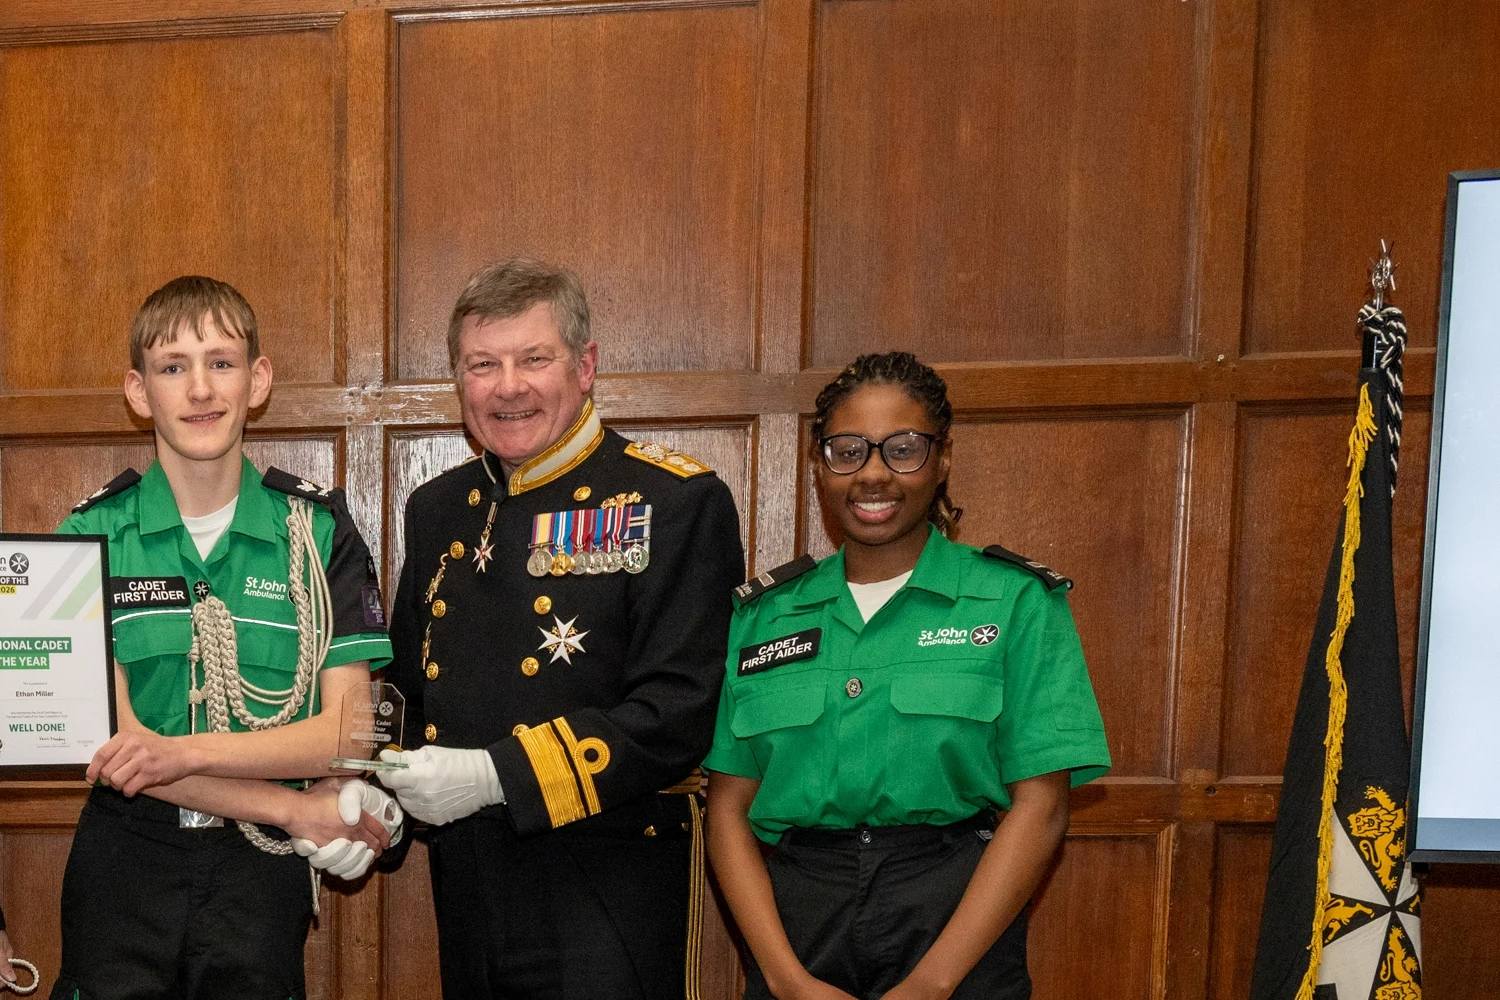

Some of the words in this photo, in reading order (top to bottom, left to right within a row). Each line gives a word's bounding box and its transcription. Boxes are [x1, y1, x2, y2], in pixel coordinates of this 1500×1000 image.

[128, 581, 167, 591] CADET
[245, 576, 258, 588] St
[259, 578, 287, 593] John
[114, 592, 147, 604] FIRST
[150, 591, 185, 601] AIDER
[243, 588, 285, 600] Ambulance
[919, 630, 933, 640] St
[935, 627, 968, 639] John
[34, 640, 69, 650] CADET
[758, 637, 799, 655] CADET
[918, 637, 966, 647] Ambulance
[19, 657, 47, 666] YEAR
[742, 652, 774, 671] FIRST
[775, 642, 813, 660] AIDER
[9, 724, 34, 732] WELL
[36, 723, 66, 732] DONE!
